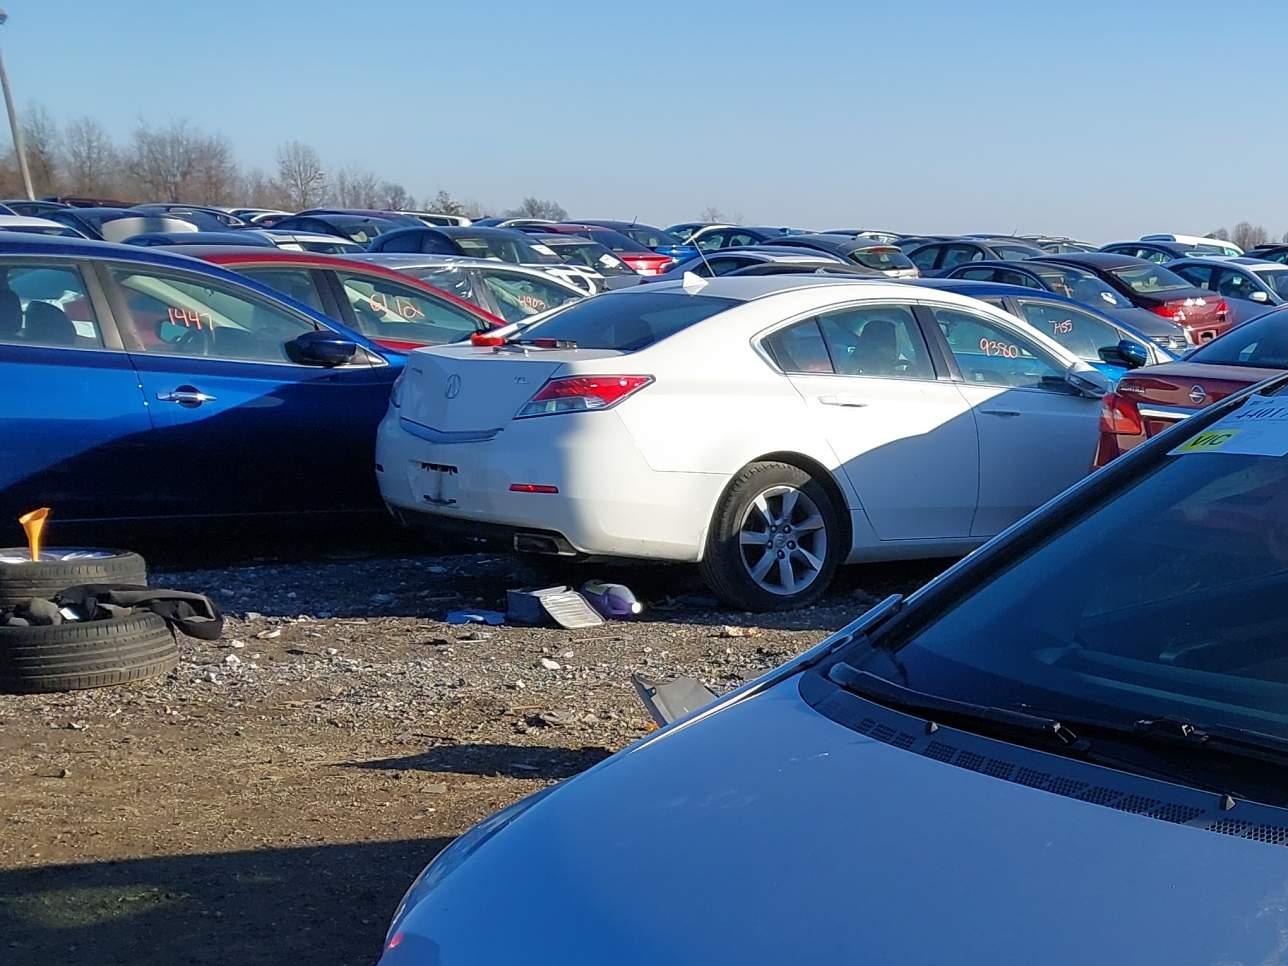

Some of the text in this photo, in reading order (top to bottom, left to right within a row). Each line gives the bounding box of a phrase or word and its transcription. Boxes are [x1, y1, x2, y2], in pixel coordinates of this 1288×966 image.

[167, 307, 214, 331] 1447
[979, 337, 1018, 359] 9380
[1190, 433, 1232, 448] VIC
